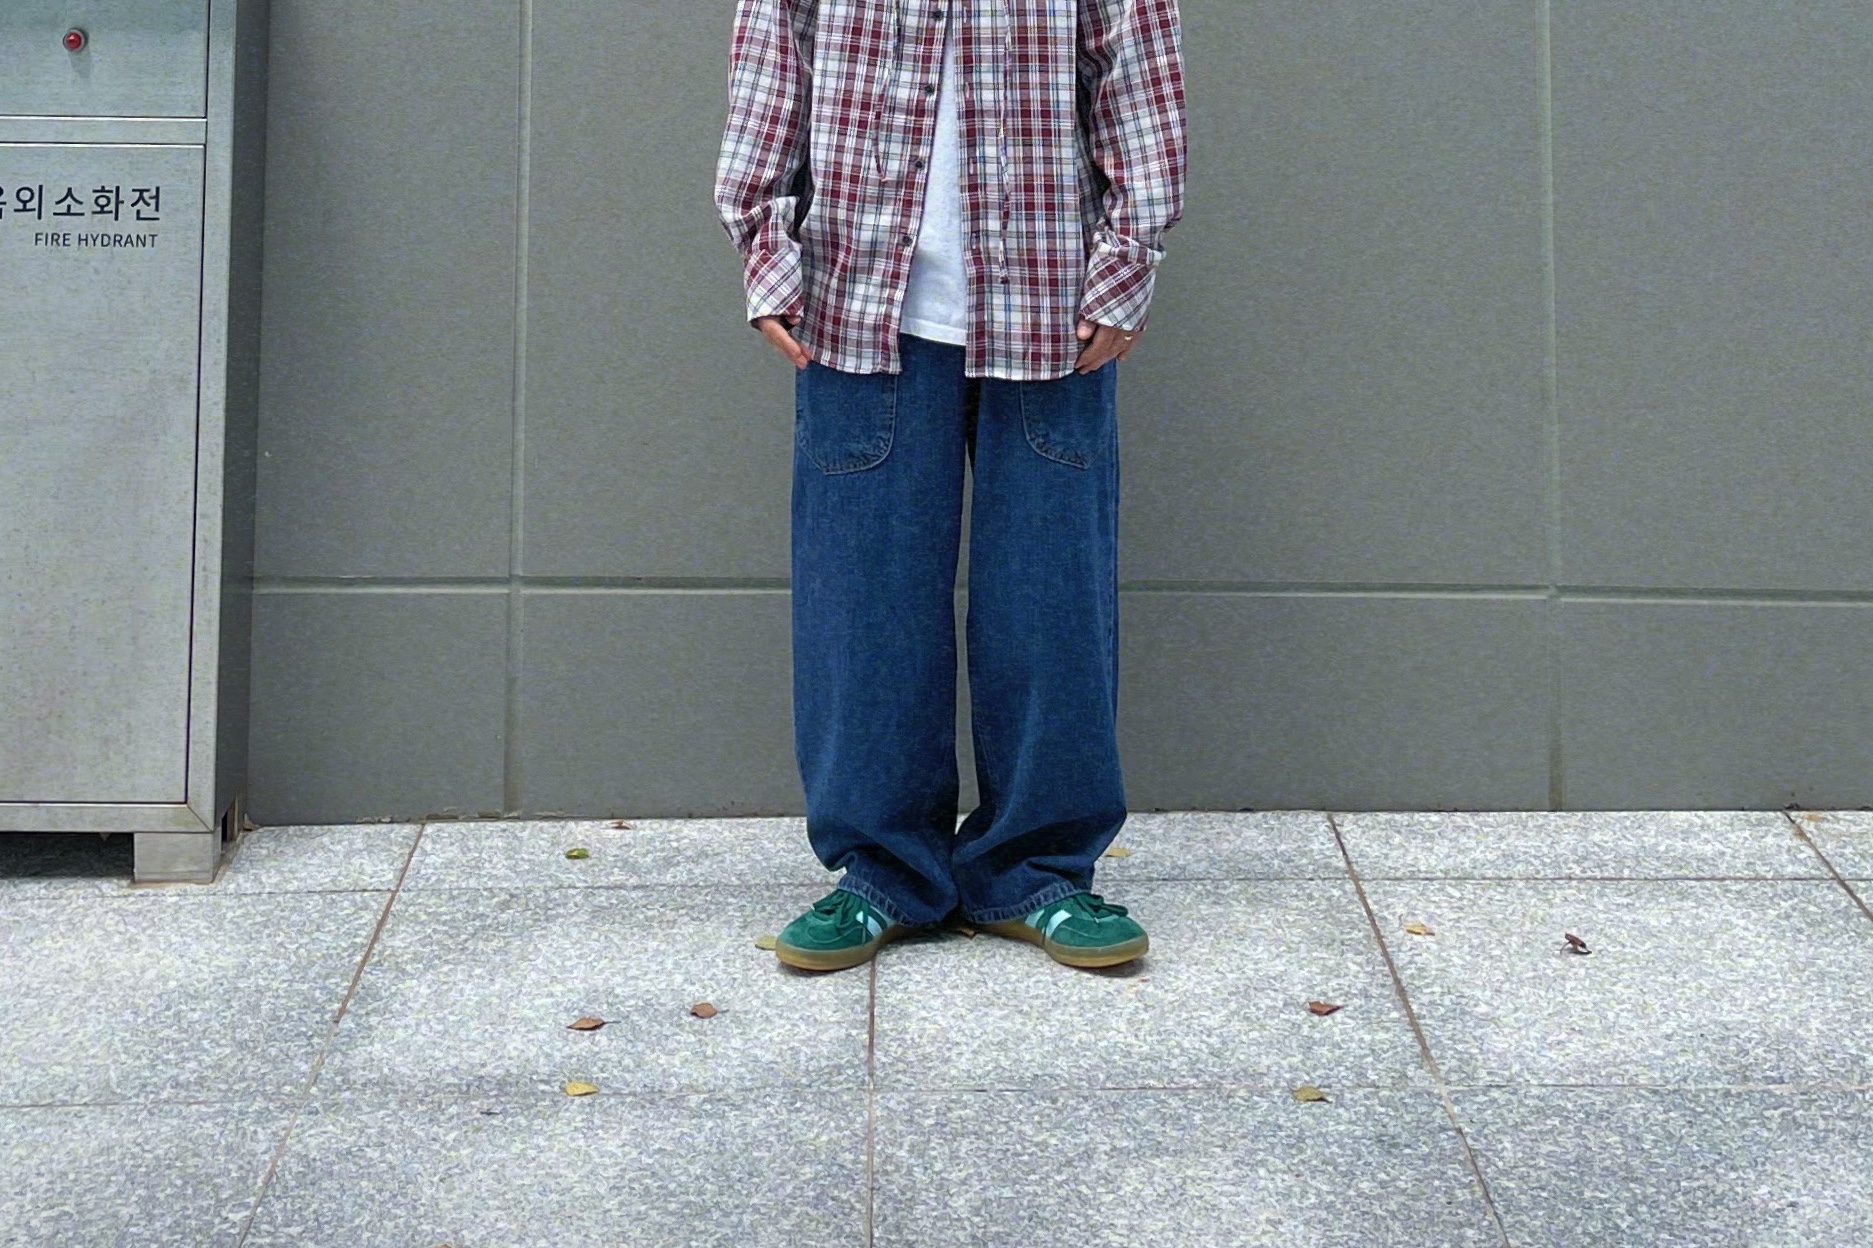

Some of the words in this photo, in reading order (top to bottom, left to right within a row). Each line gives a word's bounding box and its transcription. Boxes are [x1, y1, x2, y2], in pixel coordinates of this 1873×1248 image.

[0, 184, 160, 222] 외소화전
[34, 232, 71, 247] FIRE
[77, 233, 158, 248] HYDRANT
